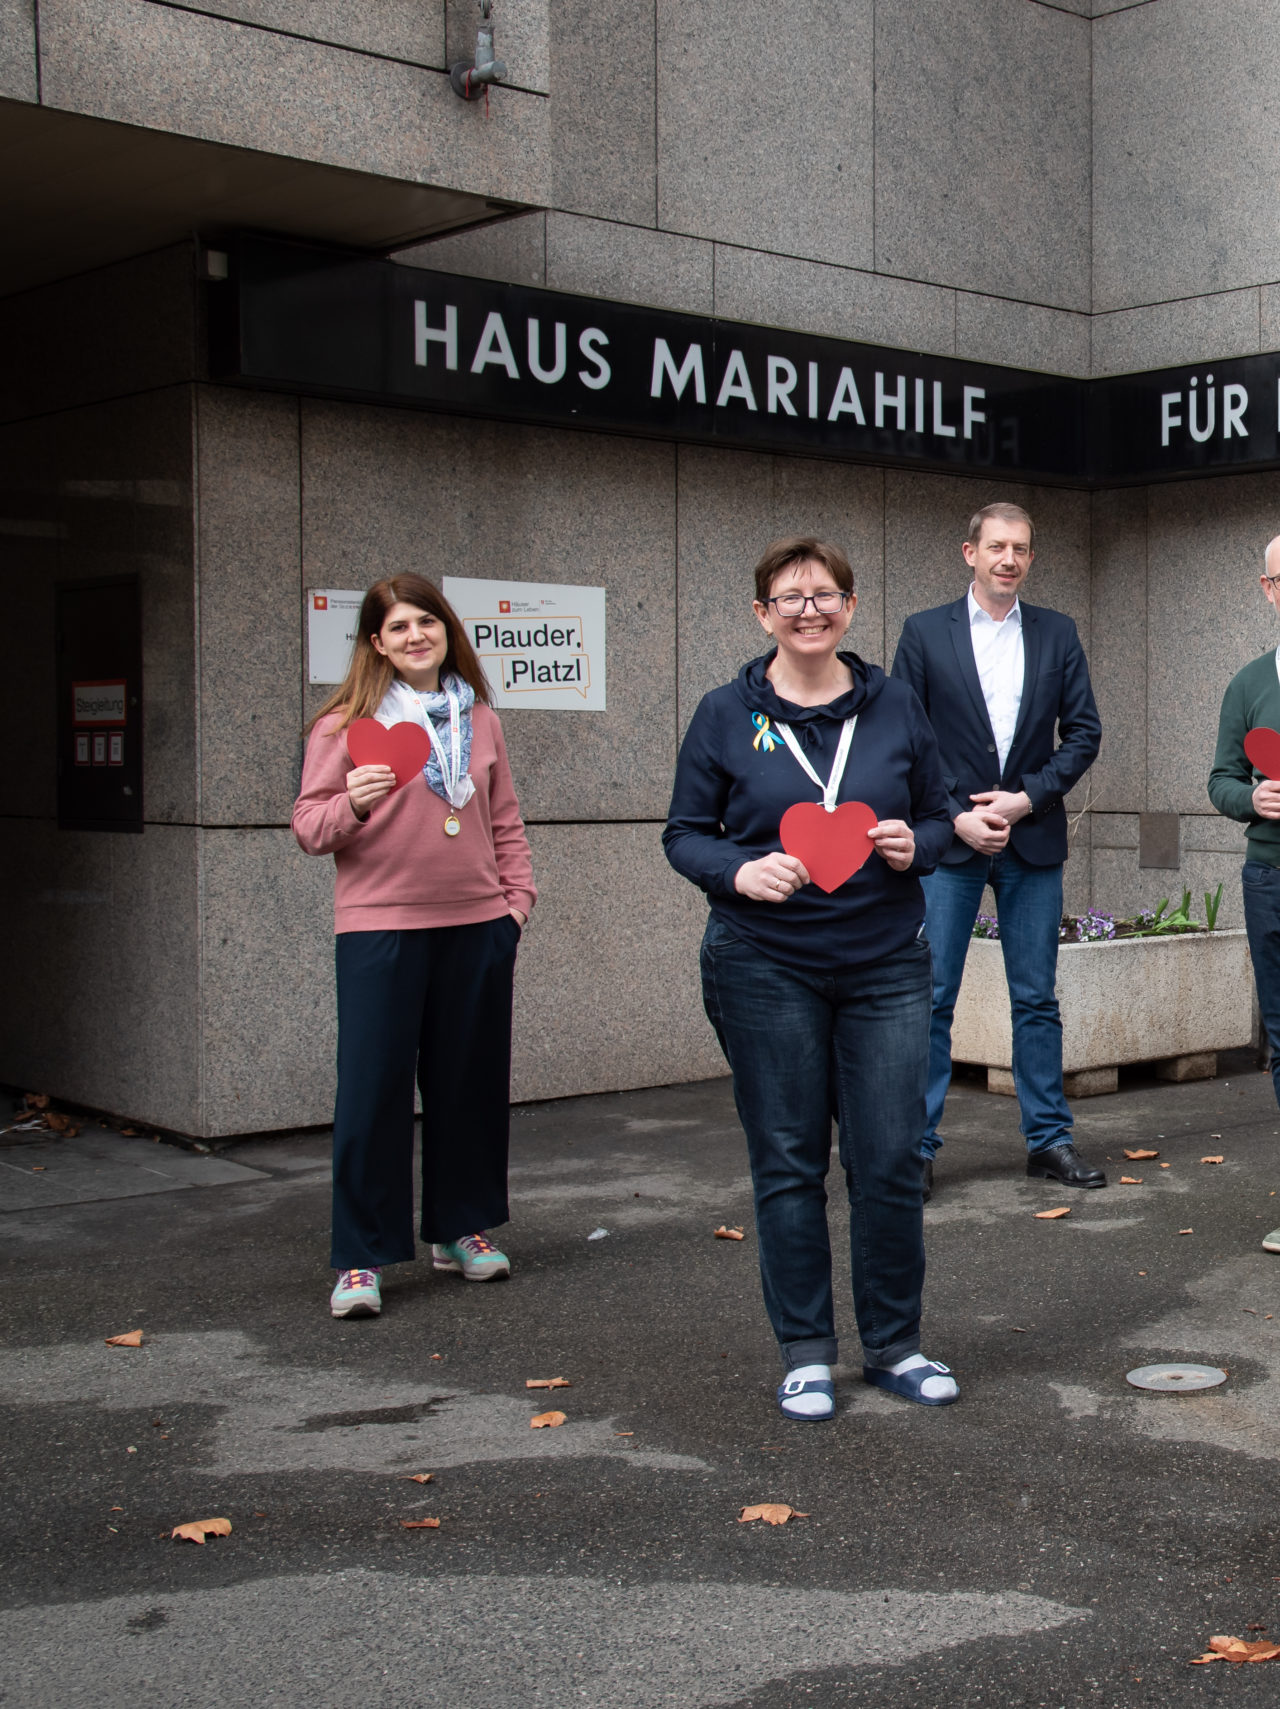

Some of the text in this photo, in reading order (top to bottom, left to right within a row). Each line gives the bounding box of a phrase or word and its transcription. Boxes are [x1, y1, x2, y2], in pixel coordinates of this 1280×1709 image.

[414, 299, 988, 440] HAUS MARIAHILF
[1161, 374, 1249, 447] FÜR
